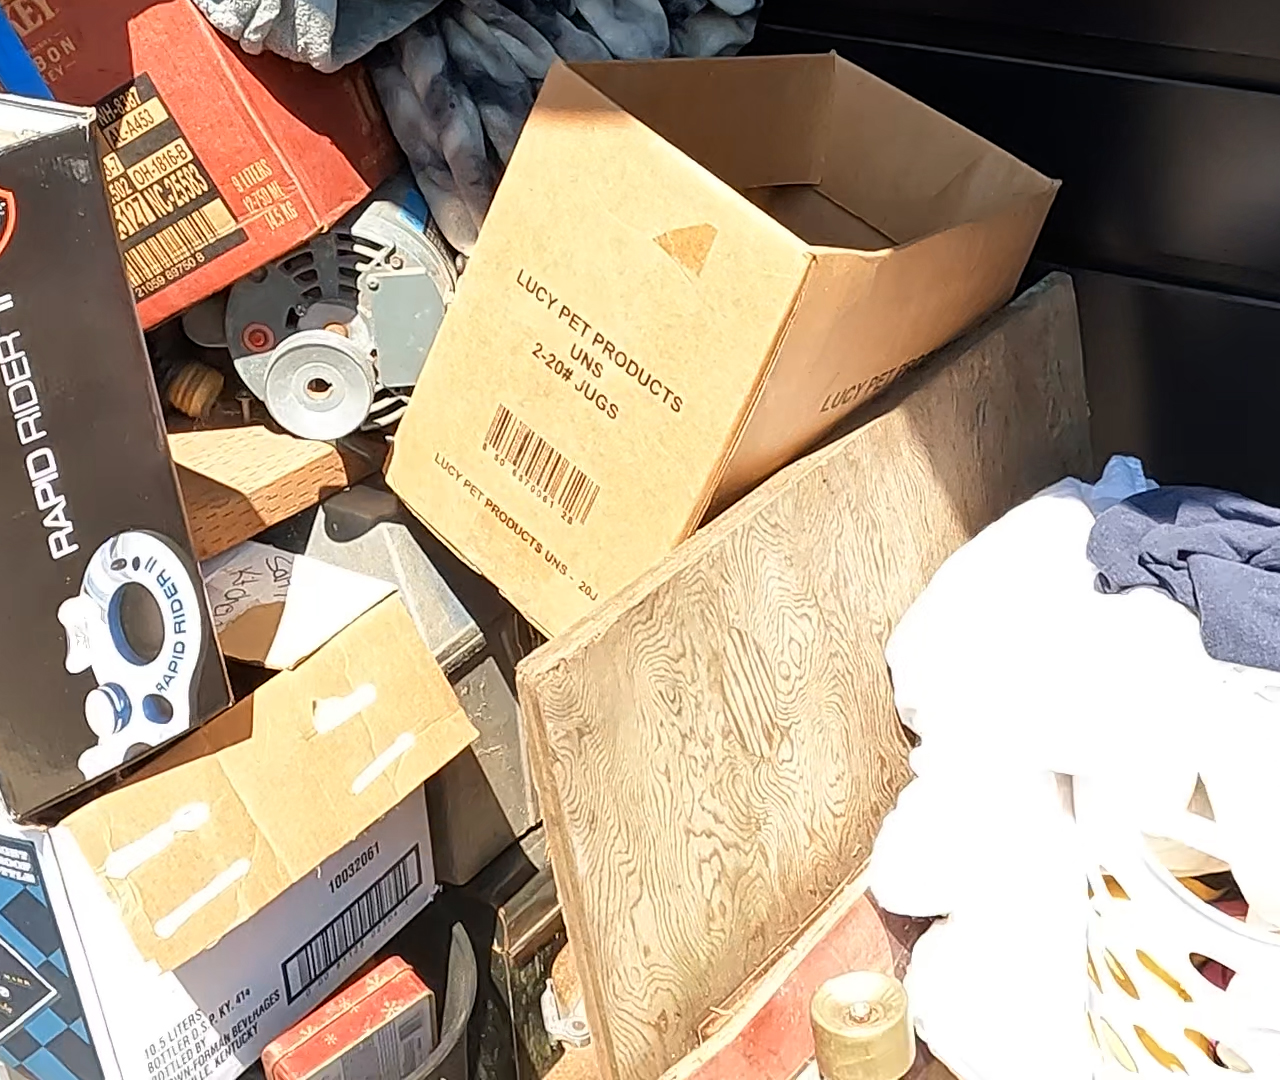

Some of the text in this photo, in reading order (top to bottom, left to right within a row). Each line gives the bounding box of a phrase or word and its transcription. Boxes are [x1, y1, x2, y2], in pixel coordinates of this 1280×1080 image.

[108, 107, 155, 145] AL-A453
[131, 142, 189, 186] OH-1816-B
[230, 158, 273, 193] 9 LITERS
[143, 163, 210, 219] NC-25583
[242, 180, 286, 215] 12-750 ML
[264, 200, 299, 231] 14.5 KG
[134, 276, 166, 298] 21059
[195, 251, 205, 264] 8
[516, 268, 683, 413] LUCY PET PRODUCTS
[569, 342, 604, 378] UNS
[531, 341, 619, 420] 2-20# JUGS
[820, 367, 897, 413] LUCY PET
[24, 446, 80, 560] RAPID
[434, 452, 463, 482] LUCY
[462, 478, 485, 501] PET
[483, 497, 544, 555] PRODUCTS
[544, 549, 568, 576] UNS
[577, 580, 599, 602] 20J
[156, 568, 187, 635] RIDER
[155, 640, 186, 694] RAPID
[327, 841, 381, 894] 10032061
[143, 1008, 203, 1060] 10.5 LITERS
[147, 1035, 192, 1074] BOTTLER
[194, 1036, 207, 1055] BY
[214, 1021, 259, 1069] KENTUCKY
